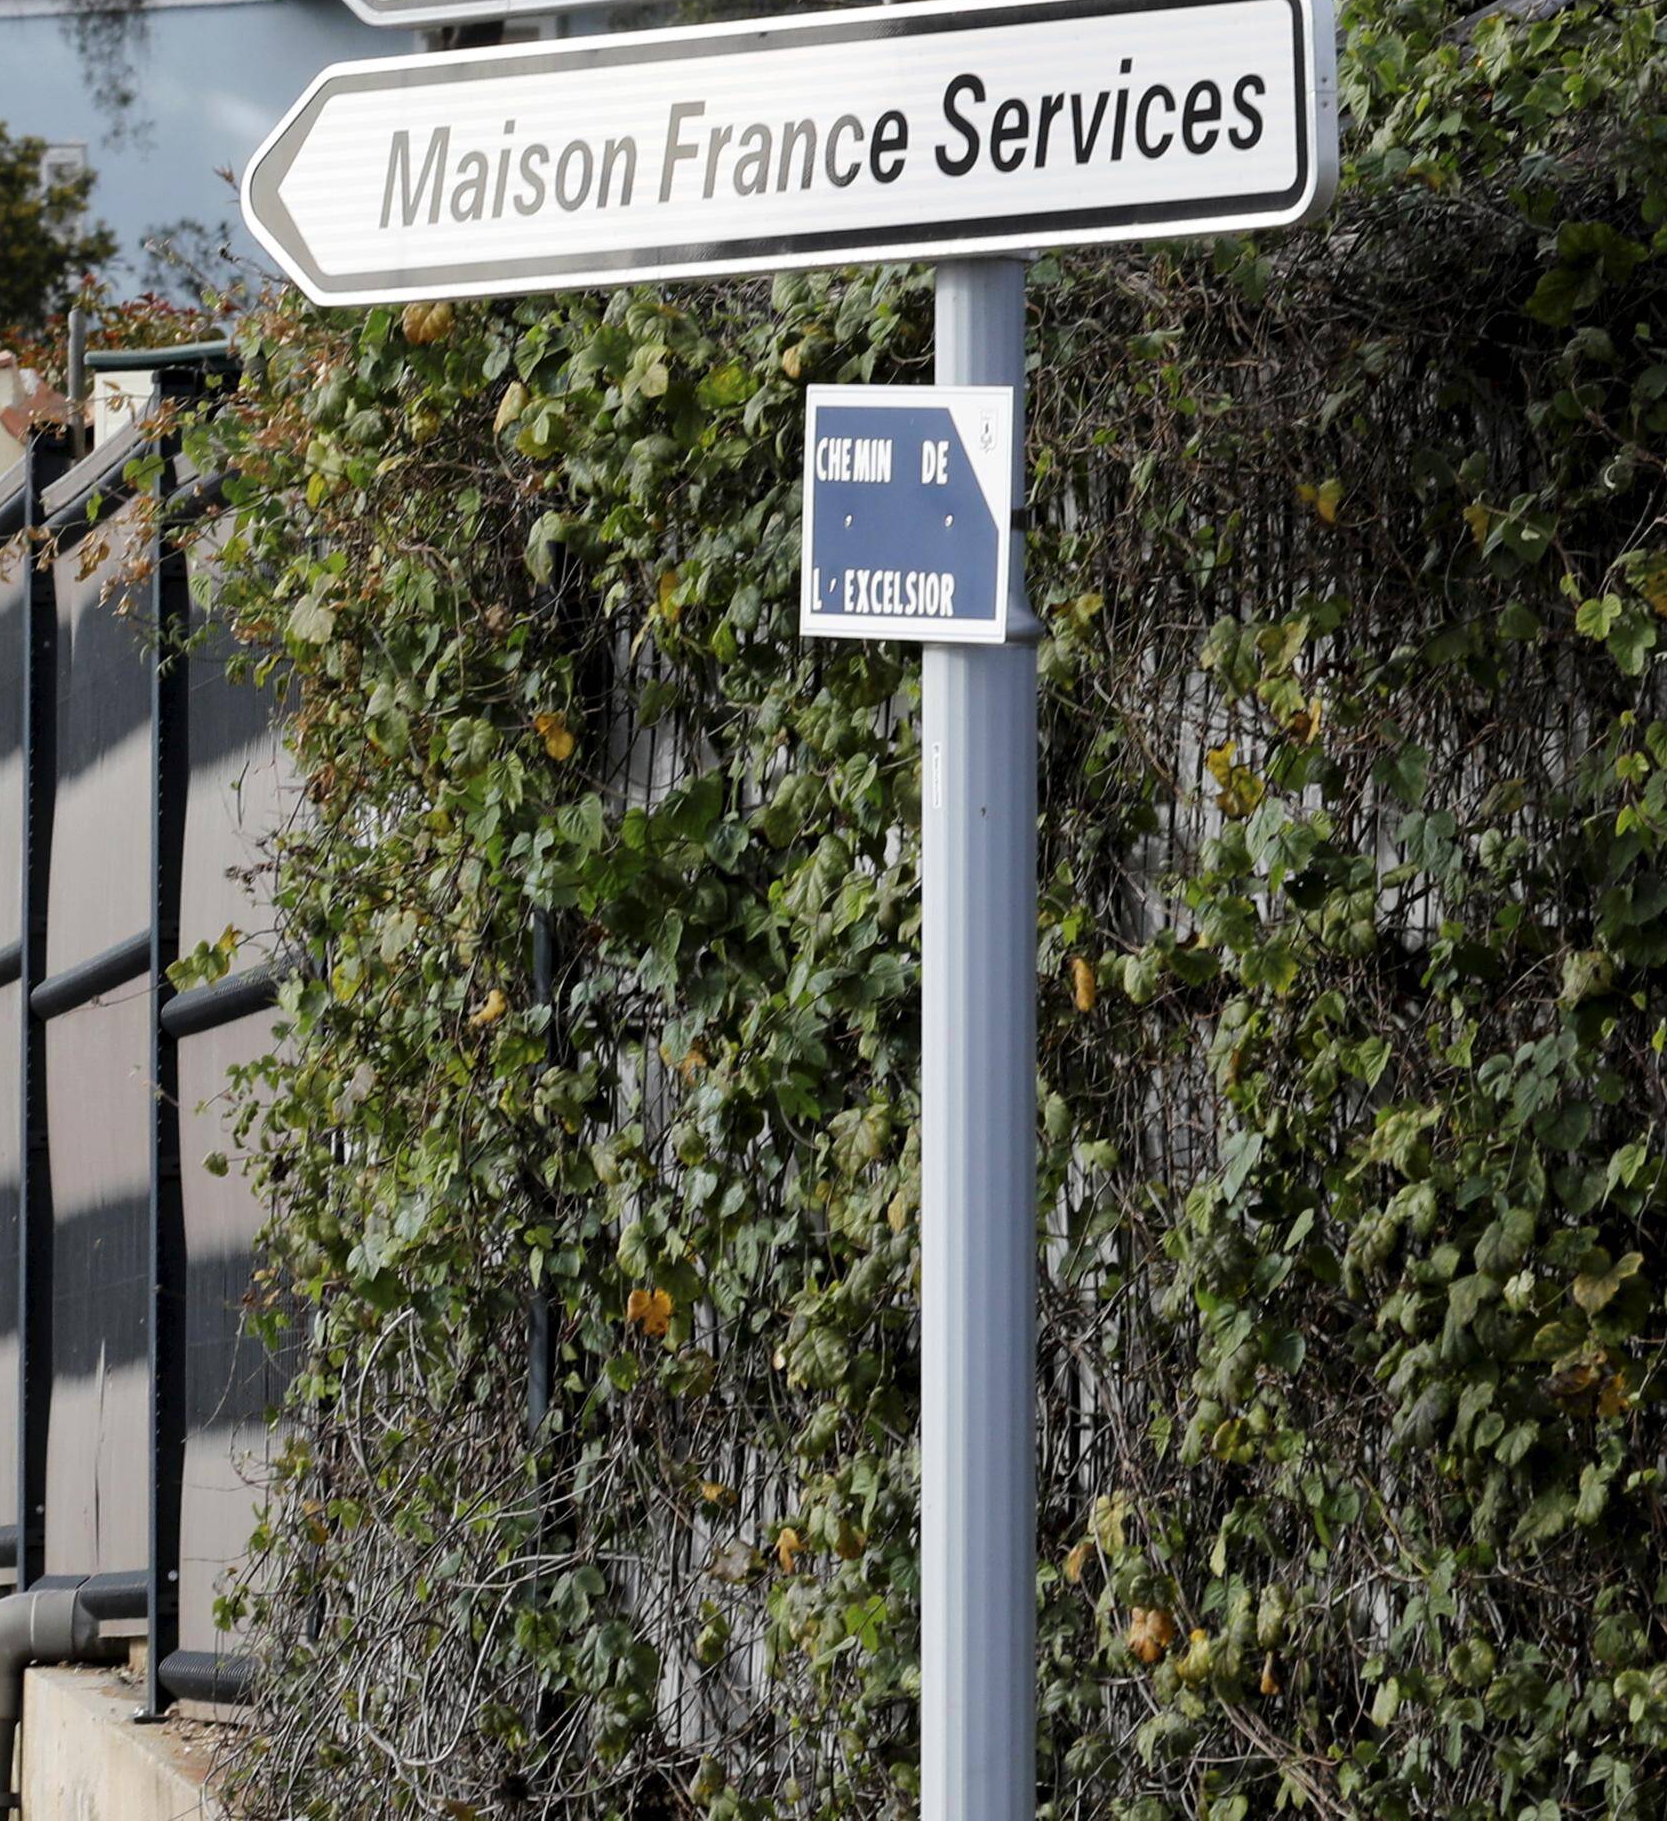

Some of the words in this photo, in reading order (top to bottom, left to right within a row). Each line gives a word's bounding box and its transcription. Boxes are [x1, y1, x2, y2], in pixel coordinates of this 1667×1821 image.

[379, 120, 641, 230] Maison
[658, 100, 907, 202] France
[935, 58, 1266, 177] Services
[816, 437, 893, 483] CHEMIN
[920, 440, 950, 485] DE
